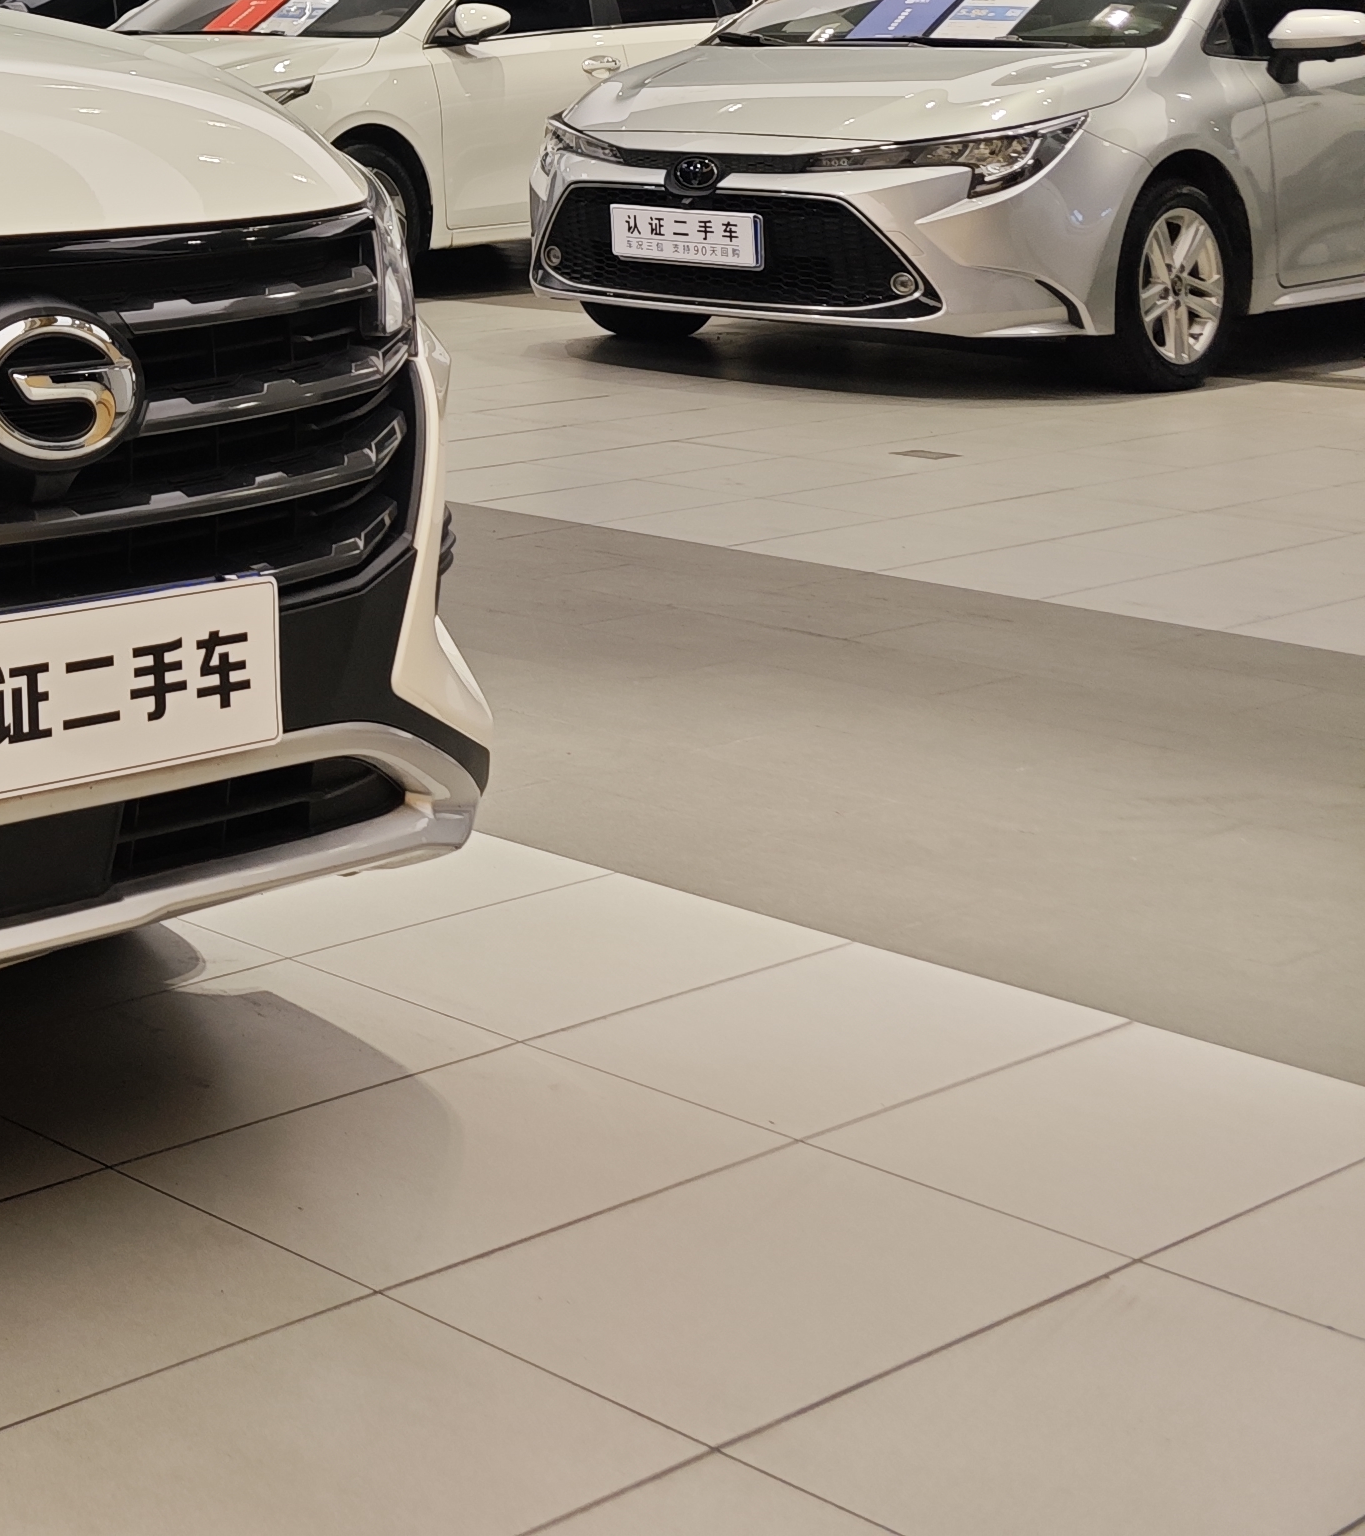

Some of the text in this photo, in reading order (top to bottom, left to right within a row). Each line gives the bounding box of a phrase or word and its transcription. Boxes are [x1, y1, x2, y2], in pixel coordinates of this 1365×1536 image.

[624, 214, 740, 244] 认证二手车
